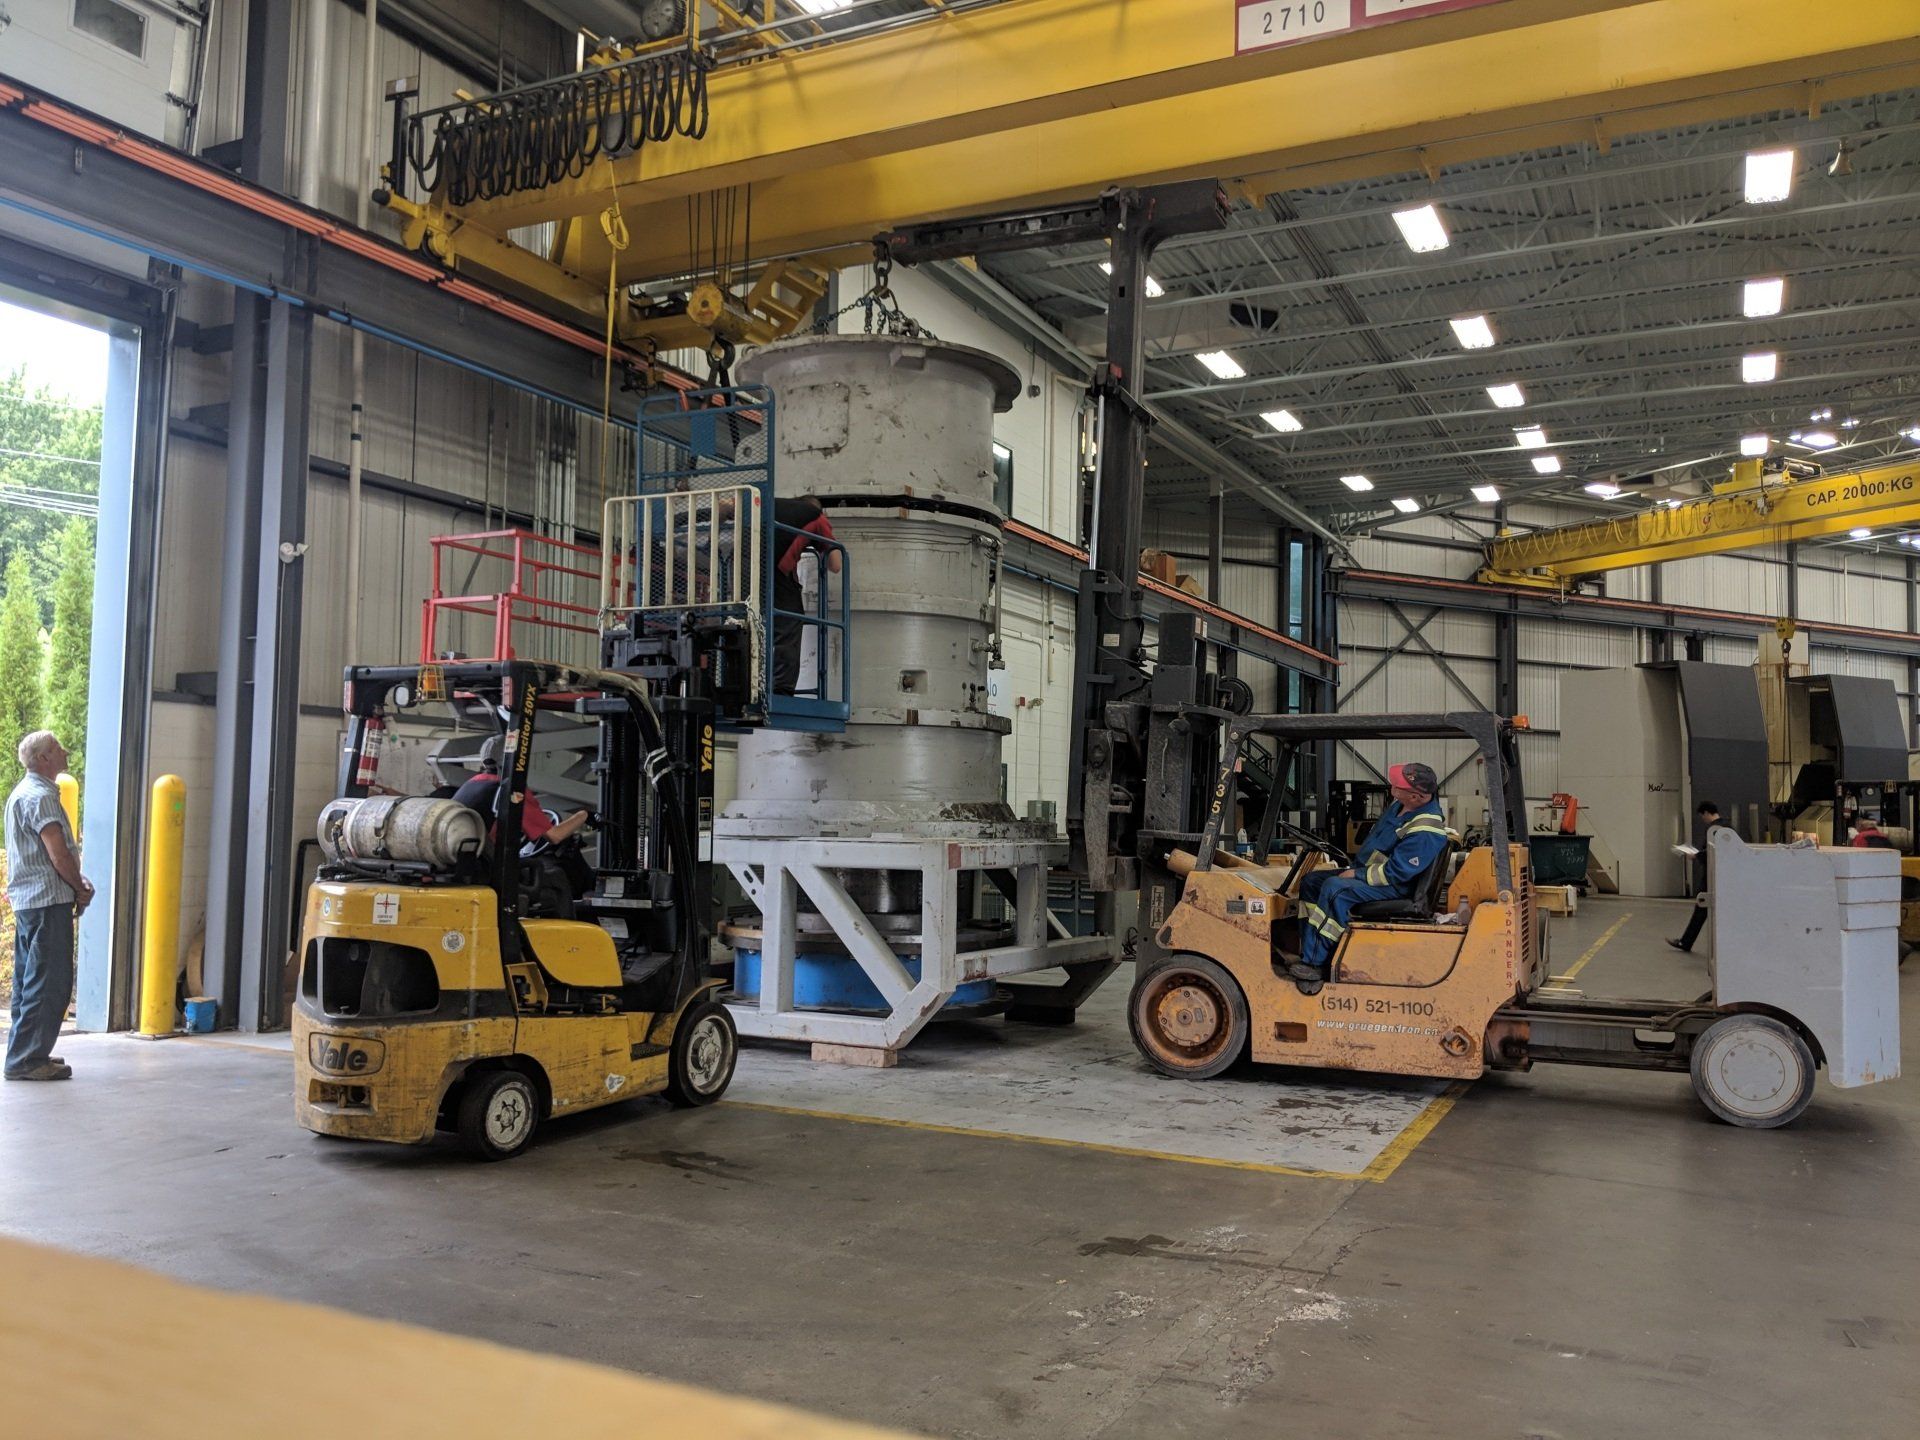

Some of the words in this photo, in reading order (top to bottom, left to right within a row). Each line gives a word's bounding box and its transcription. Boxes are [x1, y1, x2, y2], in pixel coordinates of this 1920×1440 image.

[1263, 0, 1325, 34] 2710
[1806, 490, 1838, 506] CAP.
[515, 718, 532, 771] Veracitor
[524, 683, 537, 716] 50VX
[701, 724, 713, 772] Yale
[1321, 995, 1359, 1013] (514)
[1366, 999, 1434, 1016] 521-1100
[317, 1038, 368, 1071] Yale
